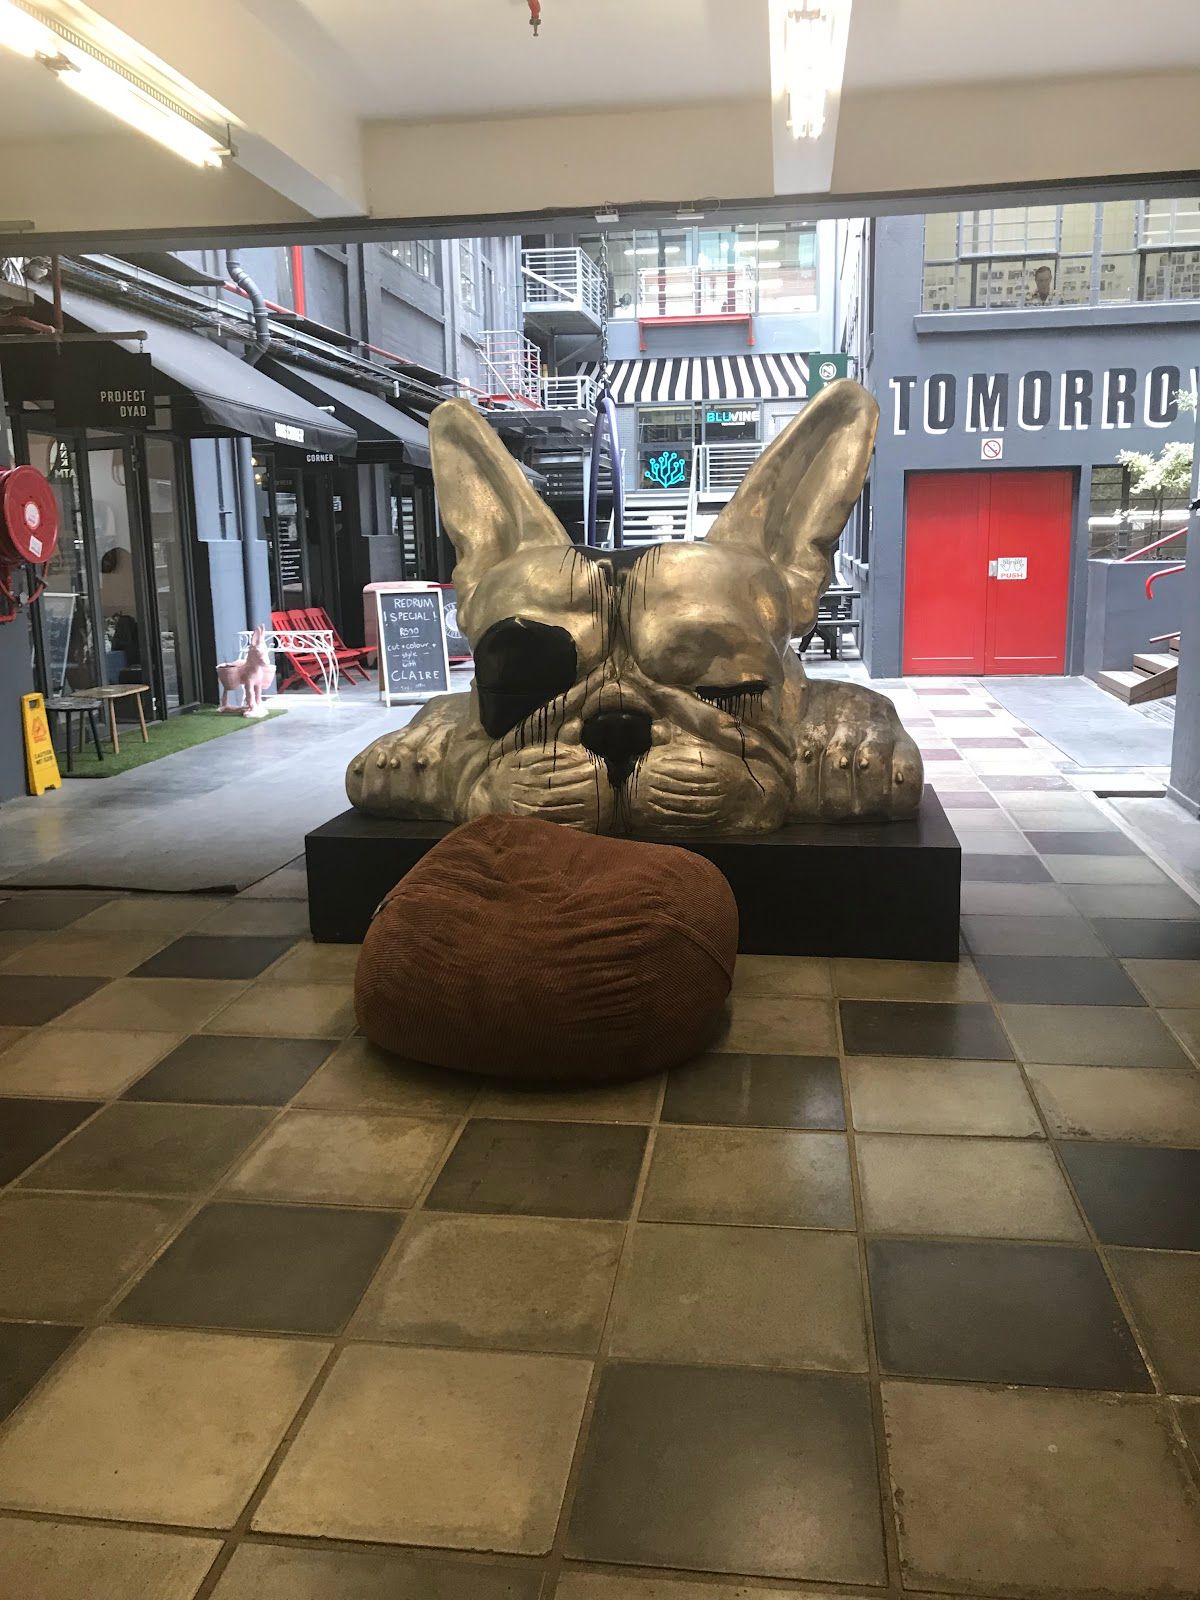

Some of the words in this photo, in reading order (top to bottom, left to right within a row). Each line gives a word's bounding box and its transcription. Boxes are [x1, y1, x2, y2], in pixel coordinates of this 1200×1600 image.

[100, 391, 145, 402] PROJECT
[889, 365, 1199, 436] TOMORRO
[120, 406, 146, 416] DYAD
[706, 411, 760, 422] BLUVINE
[306, 454, 334, 462] CORNER
[394, 598, 434, 608] REDRUM
[406, 642, 430, 650] colour
[392, 671, 440, 681] CLAIRE
